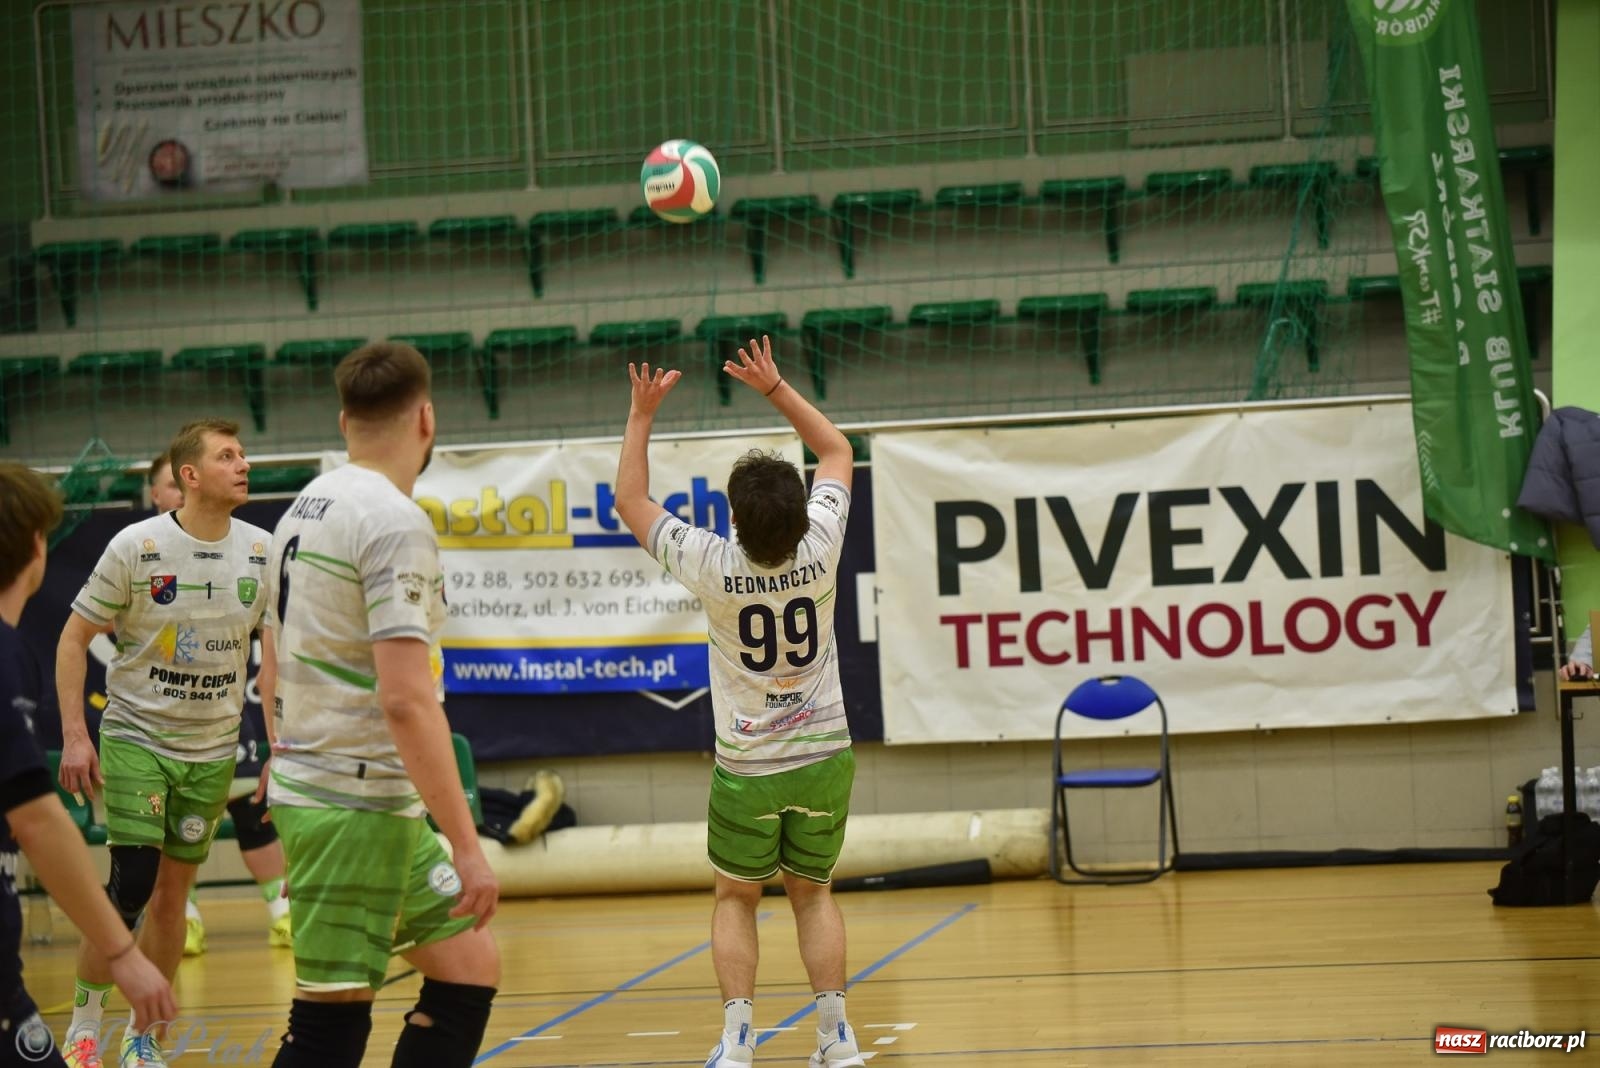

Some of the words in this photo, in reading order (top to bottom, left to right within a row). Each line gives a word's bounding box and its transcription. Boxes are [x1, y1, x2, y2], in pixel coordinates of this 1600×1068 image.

[105, 0, 325, 53] MIESZKO
[415, 477, 730, 541] nstal-tch
[933, 478, 1448, 597] PIVEXIN
[204, 581, 212, 600] 1
[452, 571, 476, 590] 92
[523, 570, 559, 589] 502
[565, 570, 602, 588] 632
[446, 599, 528, 619] acibórz,
[582, 600, 619, 615] von
[625, 595, 703, 615] Eichend
[738, 596, 819, 673] 99
[940, 590, 1448, 669] TECHNOLOGY
[149, 665, 200, 689] POMPY
[453, 653, 677, 683] www.instal-tech.pl
[162, 686, 186, 700] 605
